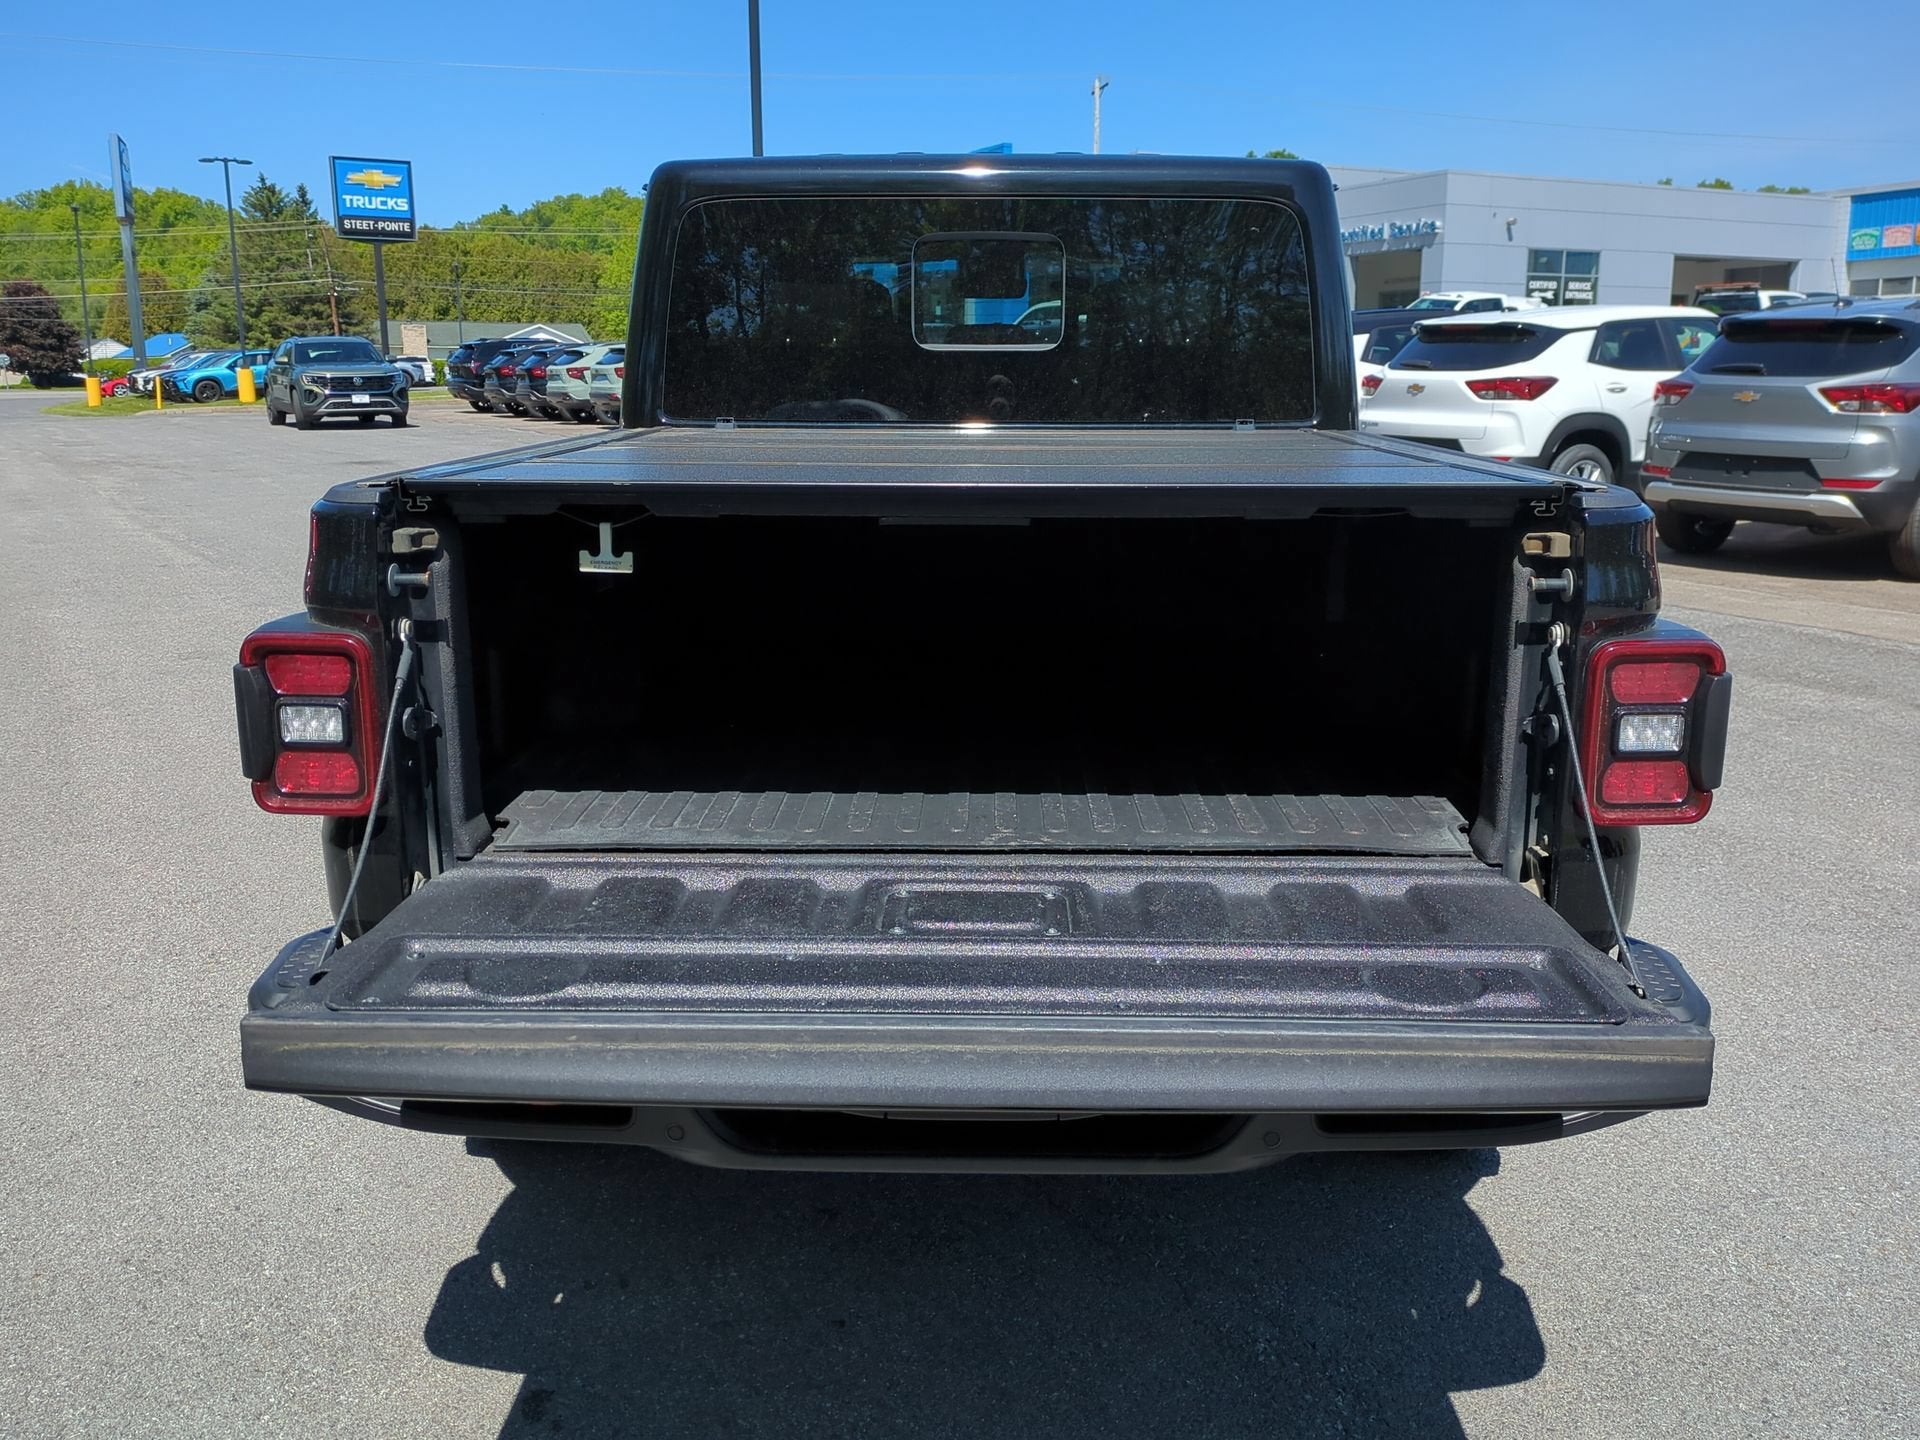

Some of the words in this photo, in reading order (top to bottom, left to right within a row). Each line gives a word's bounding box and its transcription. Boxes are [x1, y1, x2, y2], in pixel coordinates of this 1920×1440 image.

[342, 194, 409, 211] TRUCKS
[343, 219, 411, 232] STEET-PONTE
[1389, 217, 1440, 239] Service
[1528, 280, 1558, 290] CERTIFIED
[1567, 281, 1592, 290] SERVICE
